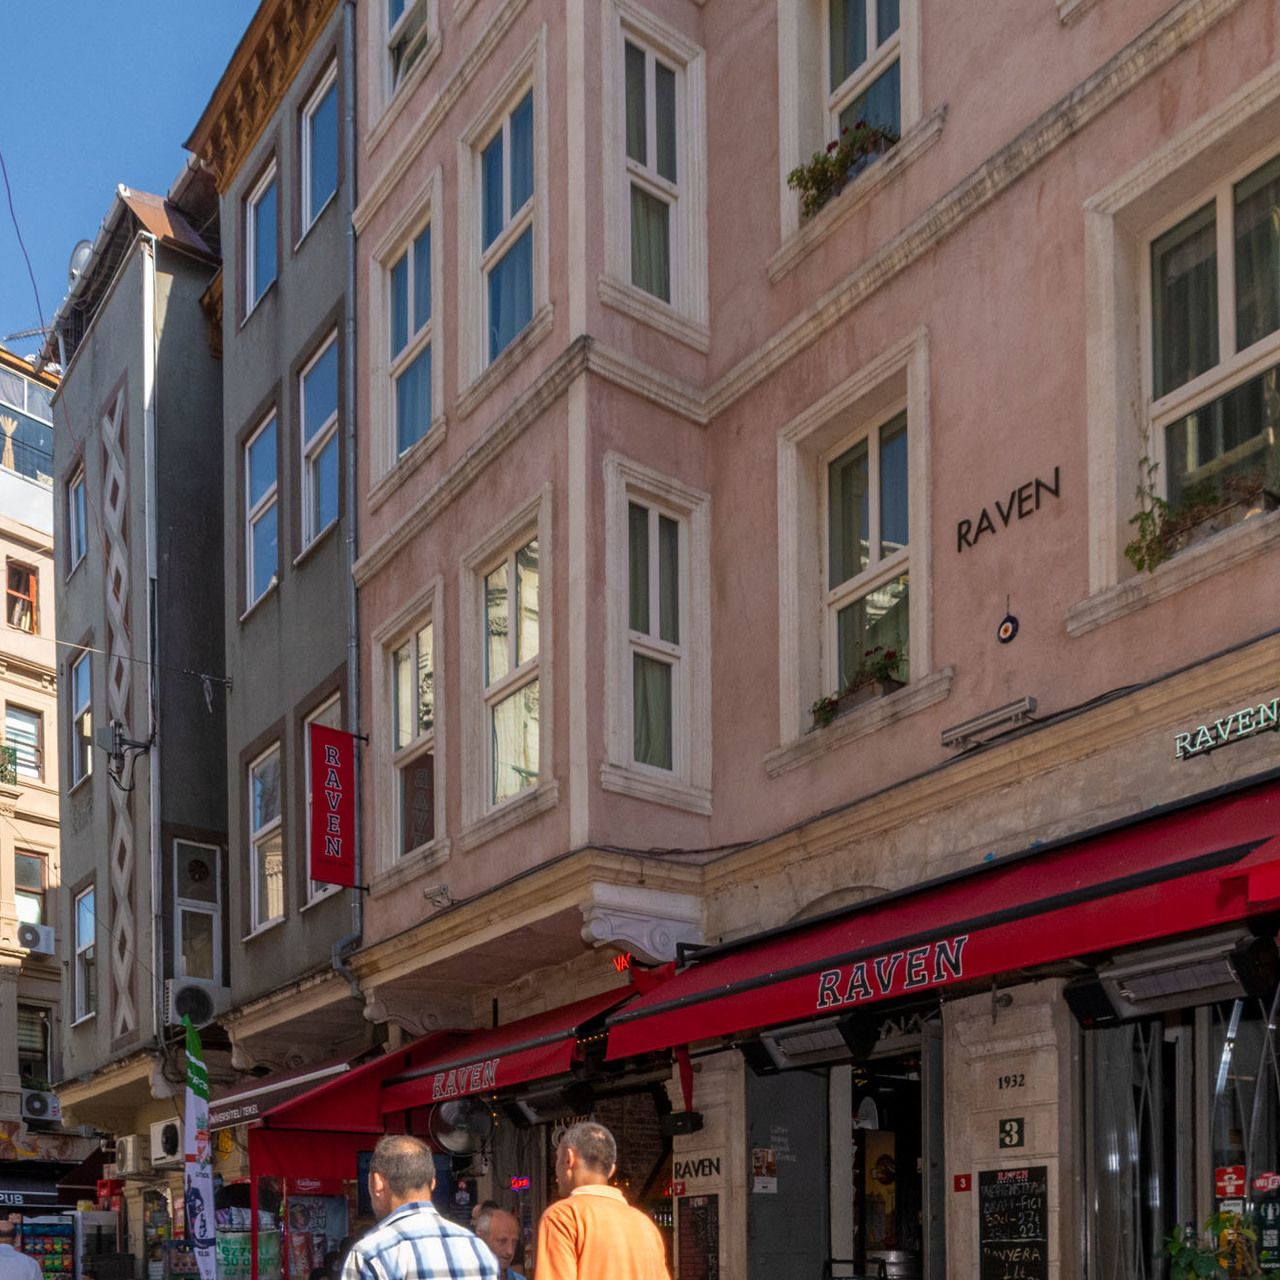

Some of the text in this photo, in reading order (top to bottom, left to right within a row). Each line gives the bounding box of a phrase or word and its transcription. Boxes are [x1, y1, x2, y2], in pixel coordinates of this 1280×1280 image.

[956, 466, 1061, 553] RAVEN
[1174, 698, 1280, 758] RAVEN
[325, 745, 342, 858] RAVEN
[817, 936, 969, 1008] RAVEN
[432, 1058, 500, 1100] RAVEN
[999, 1074, 1025, 1089] 1932
[1004, 1121, 1019, 1145] 3
[674, 1158, 720, 1179] RAVEN
